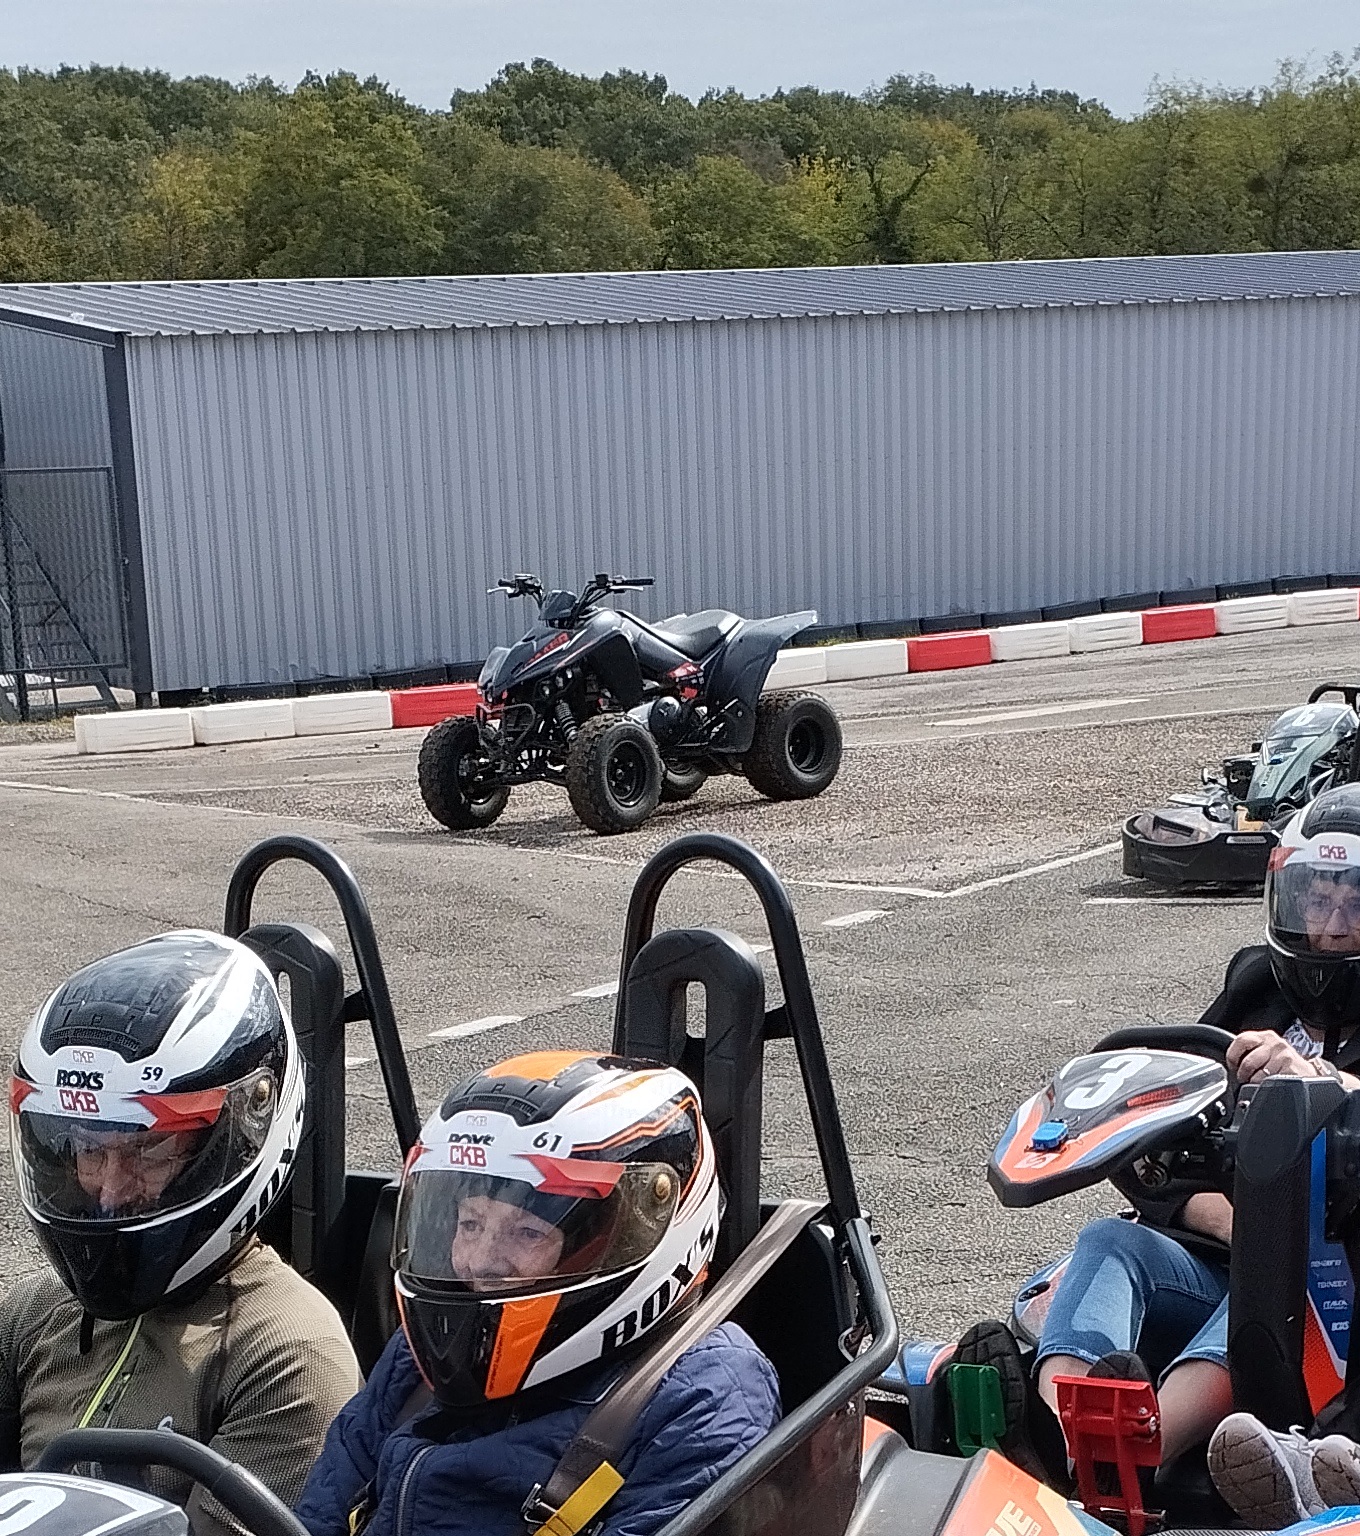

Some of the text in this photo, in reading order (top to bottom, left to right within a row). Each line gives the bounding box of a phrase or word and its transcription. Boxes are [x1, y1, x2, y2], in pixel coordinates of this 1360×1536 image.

[141, 1066, 164, 1082] 59
[1063, 1054, 1152, 1110] 3
[59, 1089, 100, 1113] CKB
[532, 1131, 563, 1152] 61
[450, 1145, 487, 1167] CKB
